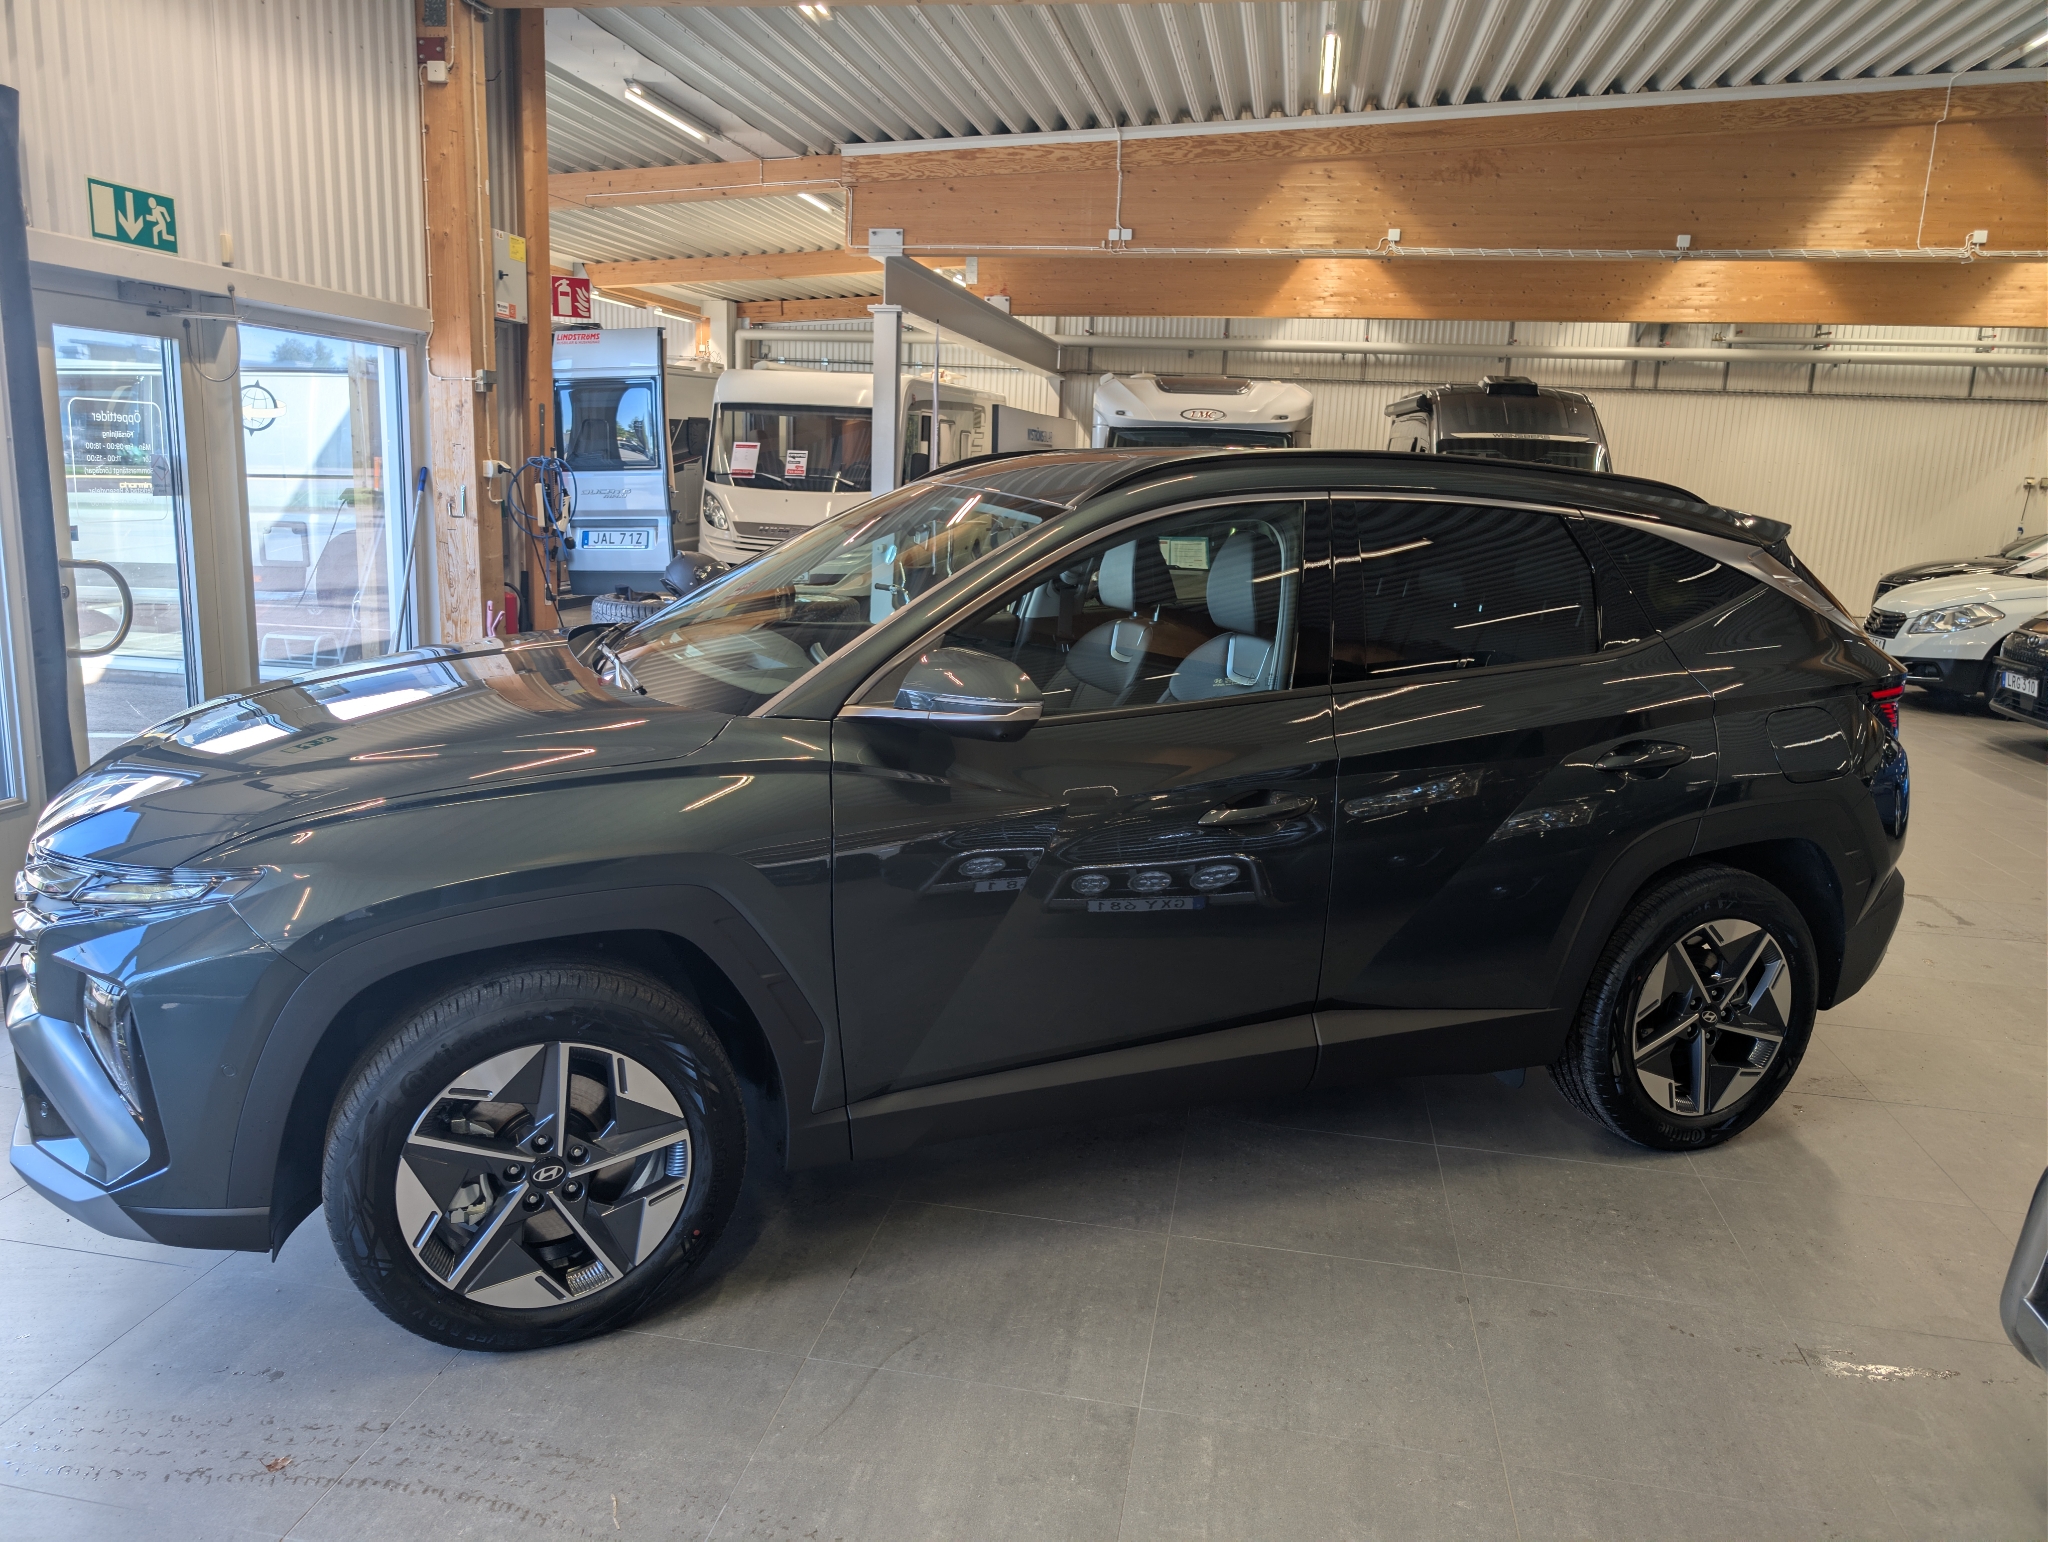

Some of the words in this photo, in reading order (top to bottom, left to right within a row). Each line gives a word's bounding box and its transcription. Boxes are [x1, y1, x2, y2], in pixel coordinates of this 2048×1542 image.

[1190, 410, 1217, 419] LMC
[593, 532, 615, 545] JAL
[619, 532, 642, 545] 71Z
[2007, 673, 2021, 690] LRG
[2021, 678, 2036, 695] 310
